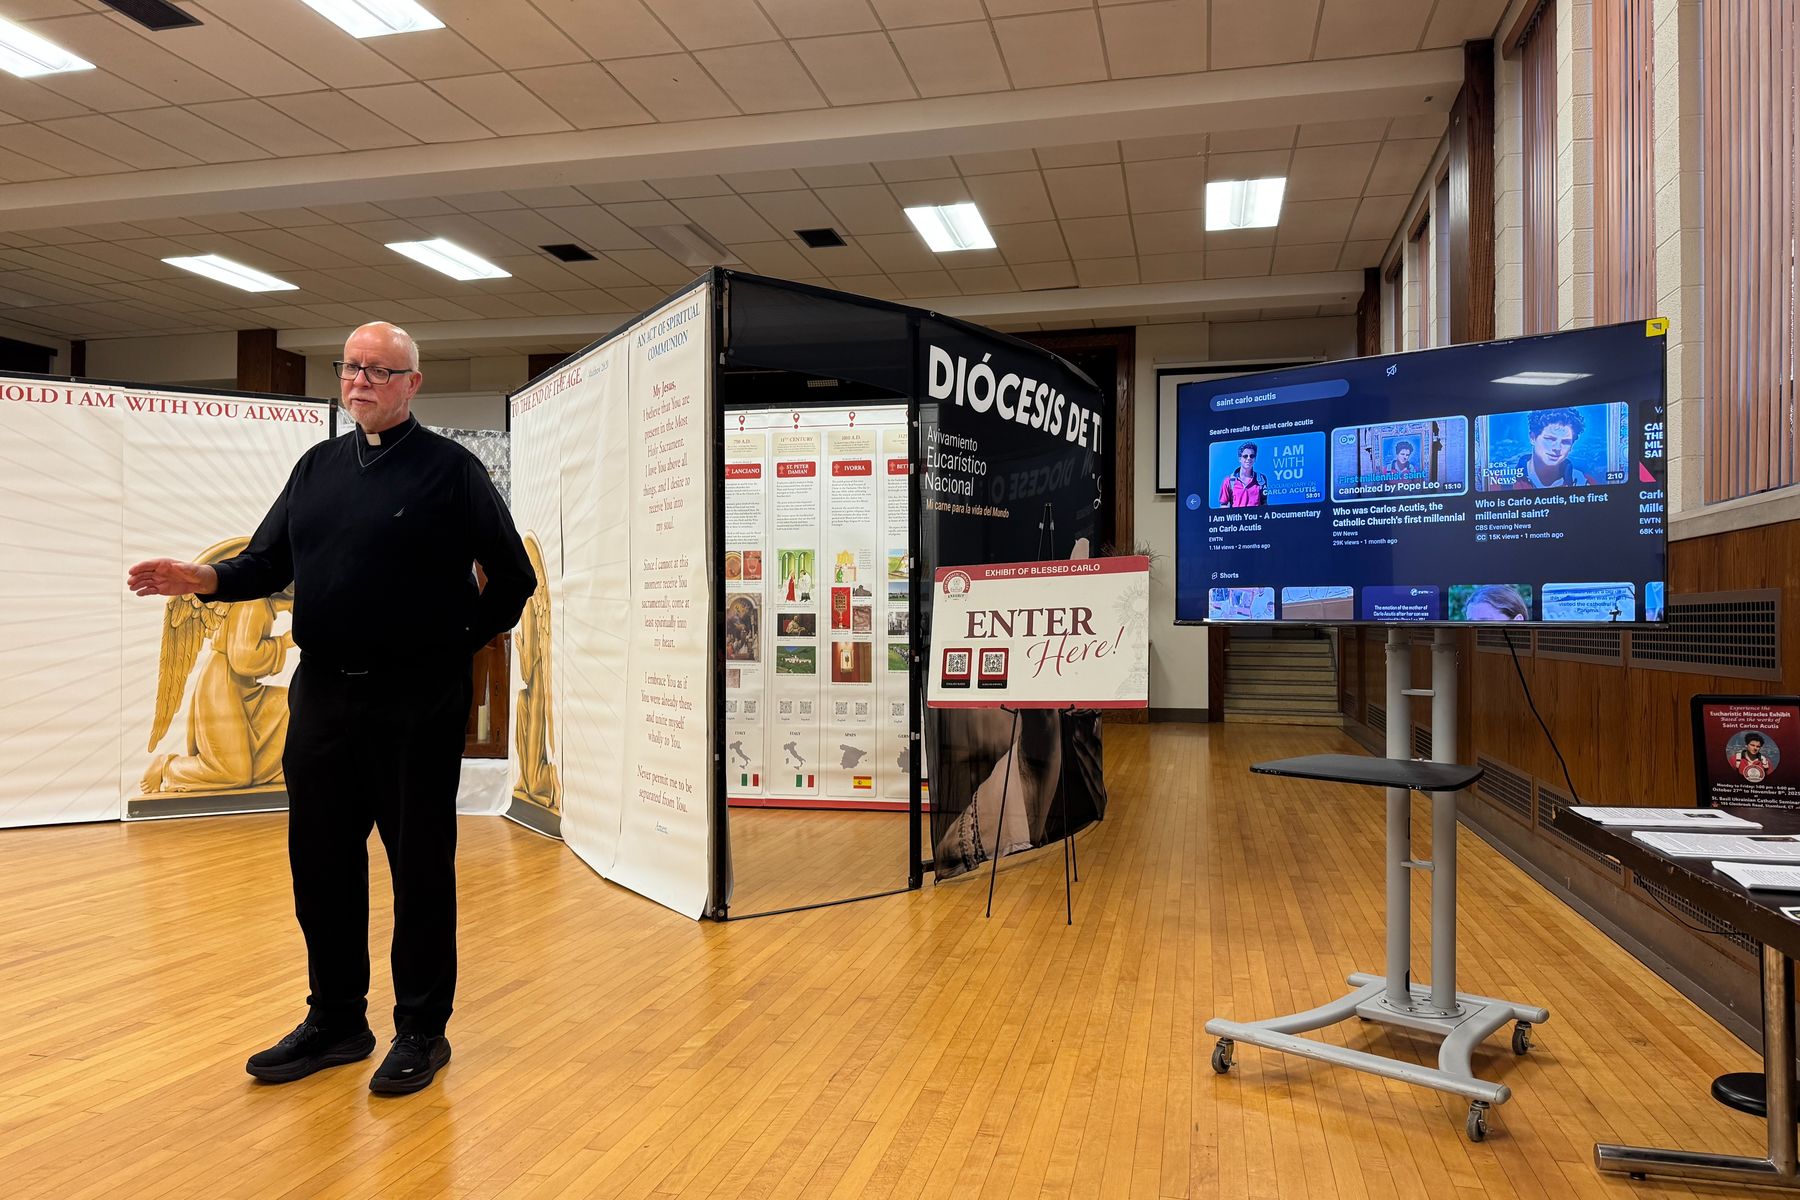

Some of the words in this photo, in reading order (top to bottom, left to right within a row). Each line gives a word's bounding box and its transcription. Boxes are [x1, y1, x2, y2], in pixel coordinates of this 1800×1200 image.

[637, 333, 646, 348] AN
[646, 326, 657, 342] ACT
[658, 321, 666, 336] OF
[666, 303, 700, 331] SPIRITUAL
[648, 330, 688, 361] COMMUNION
[512, 401, 520, 418] TO
[520, 396, 531, 414] THE
[532, 388, 544, 408] END
[544, 382, 552, 400] OF
[553, 375, 566, 396] THE
[566, 368, 582, 390] AGE.
[653, 384, 661, 399] My
[662, 381, 676, 398] Jesus,
[928, 344, 1066, 436] DIÓCESIS
[1066, 402, 1090, 448] DE
[1235, 396, 1253, 404] carlo
[1254, 392, 1276, 402] acutis
[0, 385, 58, 404] OLD
[65, 390, 72, 405] I
[78, 392, 116, 408] AM
[124, 396, 188, 414] WITH
[193, 401, 238, 418] YOU
[244, 405, 324, 426] ALWAYS,
[646, 406, 660, 420] believe
[661, 400, 670, 414] that
[671, 396, 681, 410] You
[682, 394, 690, 406] are
[927, 426, 978, 452] Avivamiento
[1274, 447, 1278, 457] I
[1282, 445, 1304, 456] AM
[926, 446, 986, 476] Eucarístico
[1273, 456, 1304, 469] WITH
[1274, 468, 1303, 480] YOU
[1360, 473, 1402, 482] millennial
[1404, 471, 1426, 480] saint
[1483, 467, 1524, 477] Evening
[924, 472, 974, 496] Nacional
[1339, 484, 1383, 494] canonized
[1385, 484, 1395, 492] by
[1398, 483, 1421, 491] Pope
[1423, 481, 1440, 489] Leo
[1490, 476, 1517, 485] News
[926, 498, 933, 510] Mi
[934, 502, 951, 511] carne
[952, 505, 964, 514] para
[966, 503, 970, 514] la
[972, 504, 982, 514] vida
[984, 506, 992, 516] del
[992, 507, 1009, 518] Mundo
[1370, 505, 1396, 514] Carlos
[1398, 503, 1427, 512] Acutis,
[1429, 502, 1443, 511] the
[1475, 499, 1495, 508] Who
[1498, 498, 1505, 507] is
[1508, 497, 1532, 506] Carlo
[1534, 495, 1567, 505] Acutis,
[1569, 494, 1585, 503] the
[1588, 493, 1608, 502] first
[1272, 510, 1321, 519] Documentary
[1333, 518, 1365, 527] Catholic
[1367, 516, 1402, 525] Church's
[1404, 515, 1422, 523] first
[1424, 513, 1465, 522] millennial
[1475, 510, 1519, 520] millennial
[1521, 509, 1549, 518] saint?
[1239, 524, 1261, 532] Acutis
[985, 568, 1016, 577] EXHIBIT
[1031, 566, 1068, 574] BLESSED
[1070, 564, 1100, 572] CARLO
[964, 606, 1096, 638] ENTER
[1026, 626, 1125, 678] Here!
[637, 764, 652, 780] Never
[652, 773, 668, 786] permit
[670, 778, 677, 788] me
[678, 781, 684, 791] to
[686, 778, 692, 793] be
[639, 789, 661, 803] separated
[662, 792, 674, 808] from
[677, 796, 688, 813] You.
